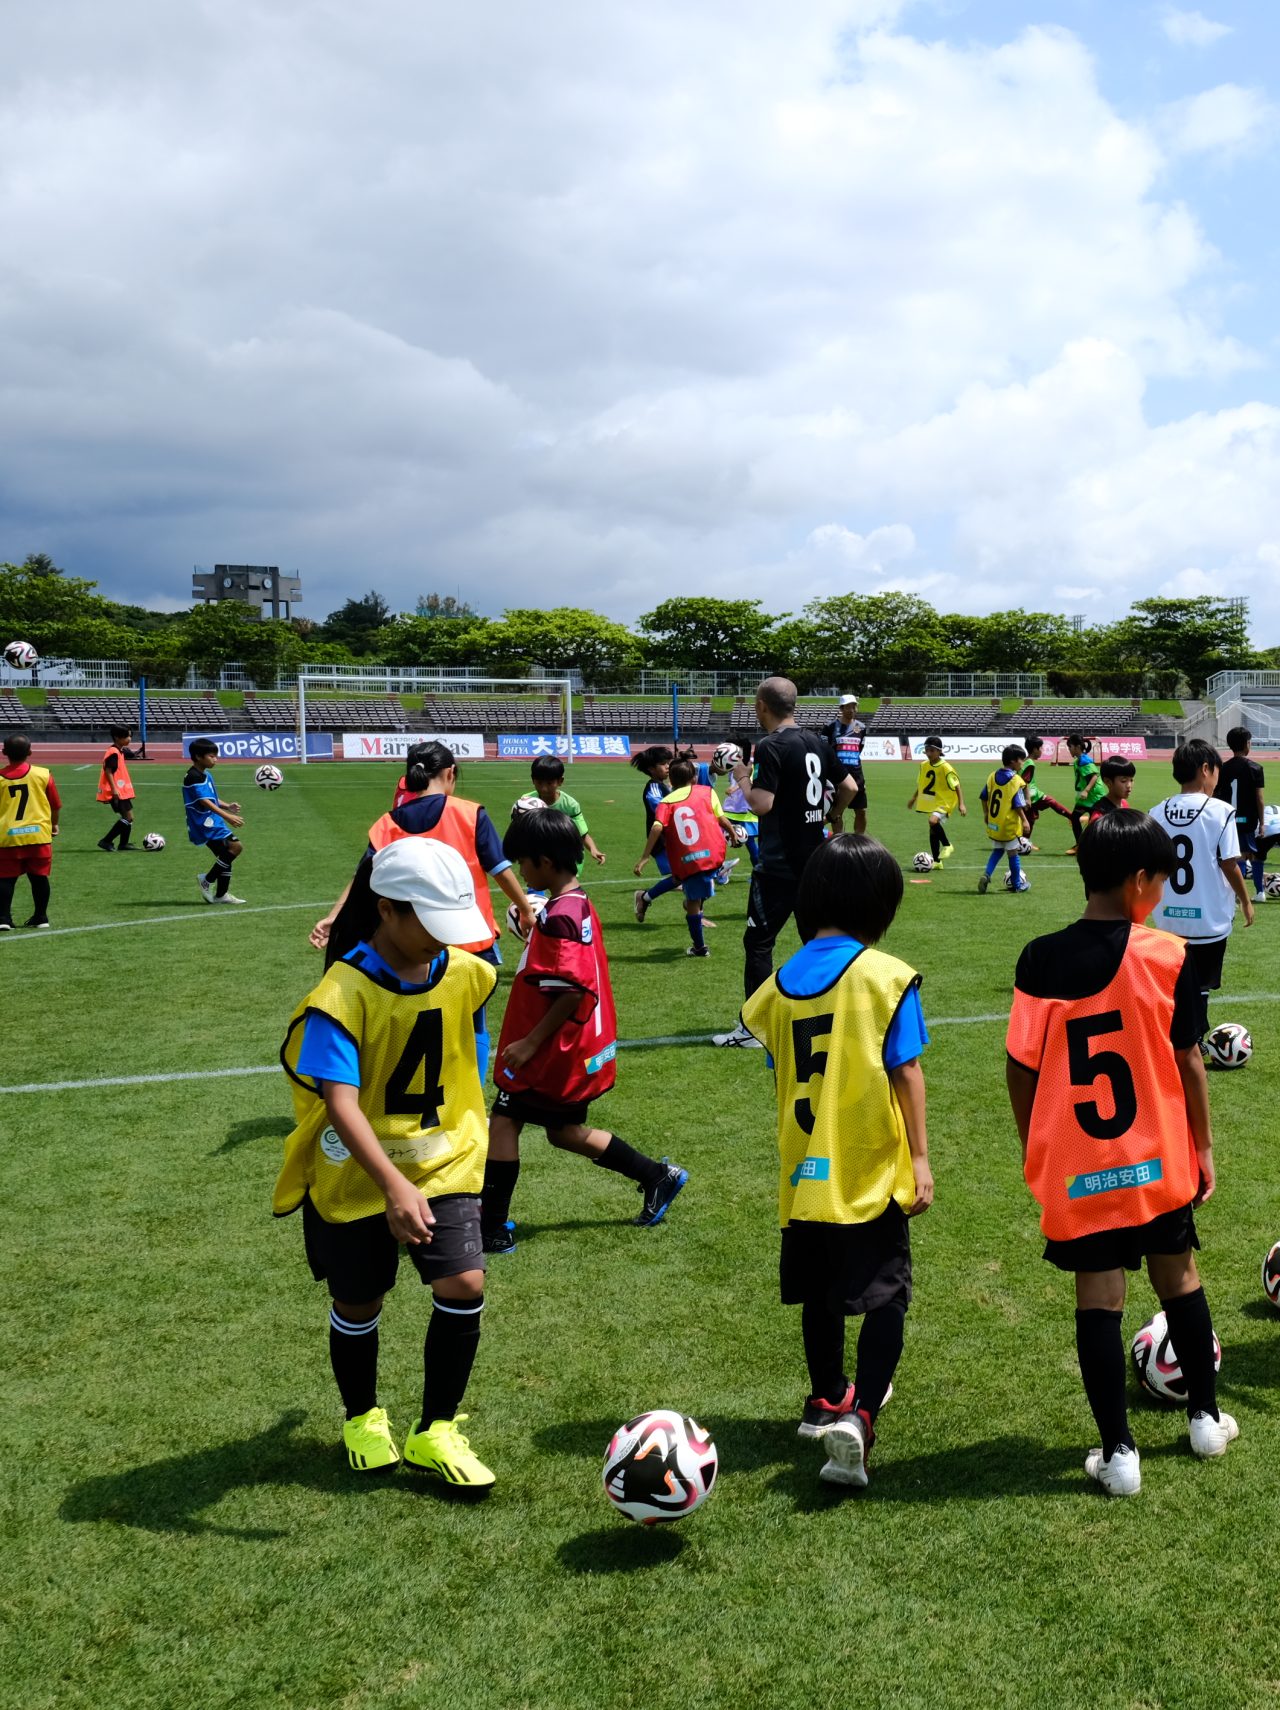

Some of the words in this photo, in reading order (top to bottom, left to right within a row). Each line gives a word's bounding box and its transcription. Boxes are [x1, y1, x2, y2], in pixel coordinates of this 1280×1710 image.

[503, 746, 529, 755] OHYA
[805, 752, 823, 806] 8
[923, 770, 936, 796] 2
[8, 784, 30, 821] 7
[990, 788, 1003, 818] 6
[673, 806, 701, 846] 6
[1169, 834, 1195, 895] 8
[1168, 907, 1196, 918] 明治安田
[384, 1007, 445, 1131] 4
[791, 1012, 835, 1136] 5
[1065, 1009, 1138, 1141] 5
[1084, 1165, 1150, 1192] 明治安田
